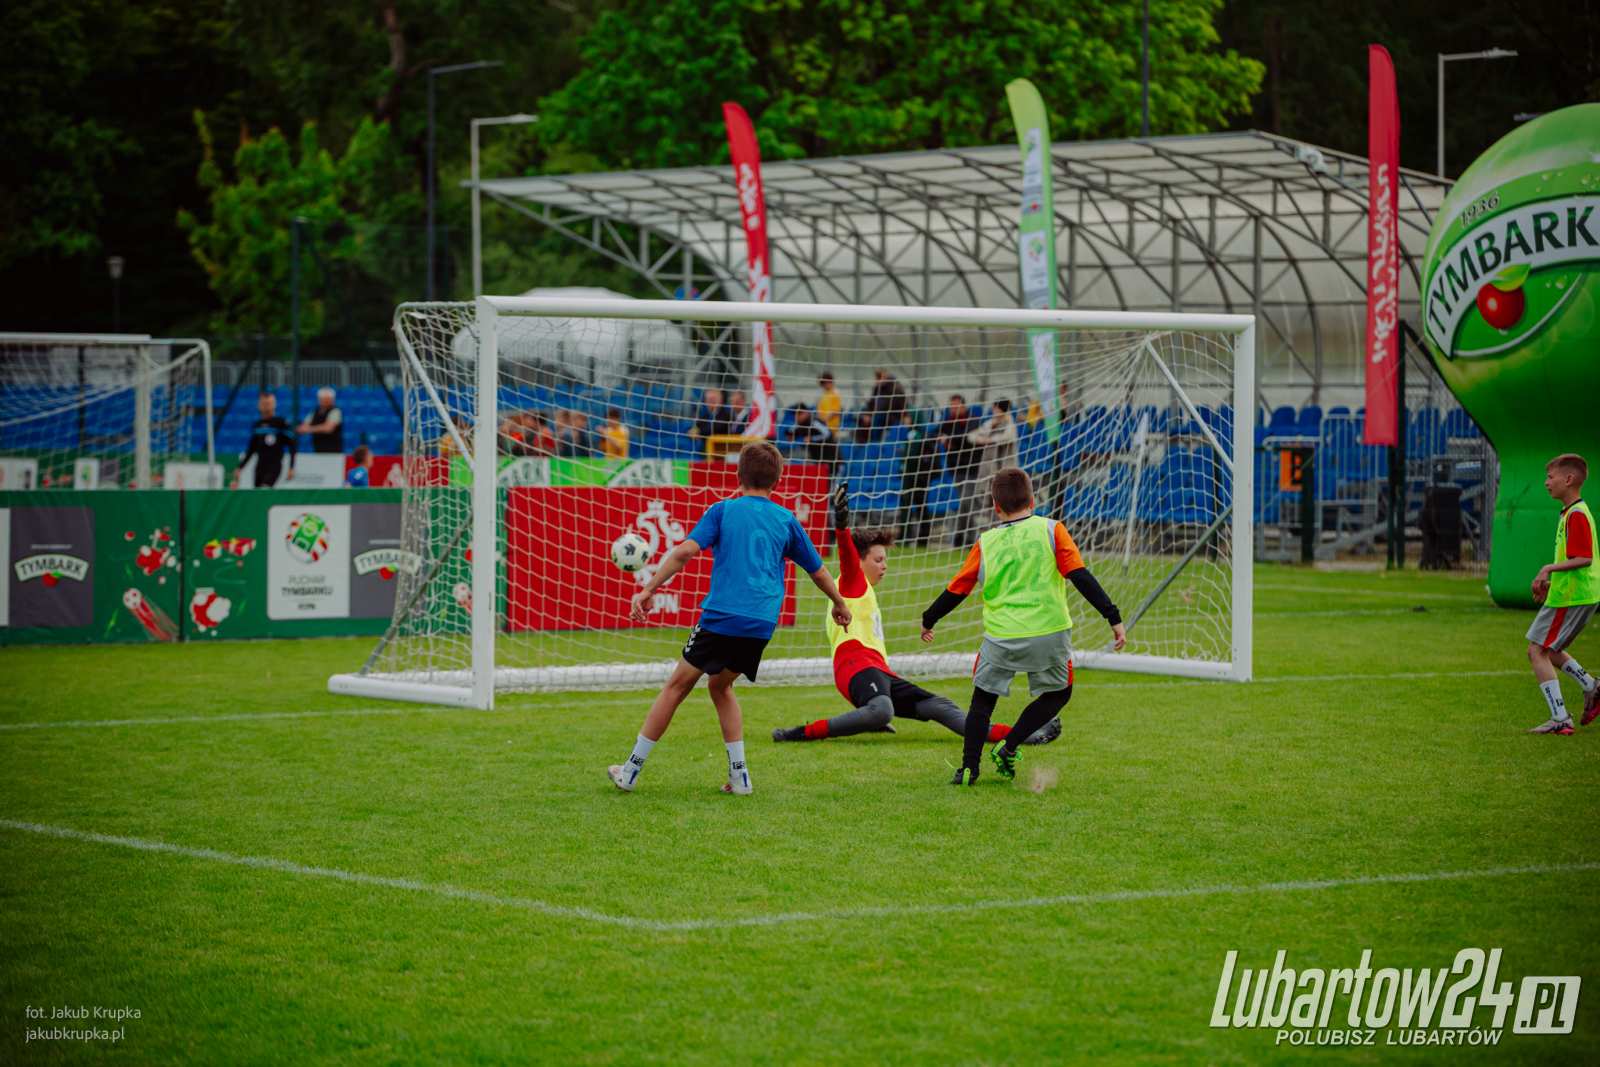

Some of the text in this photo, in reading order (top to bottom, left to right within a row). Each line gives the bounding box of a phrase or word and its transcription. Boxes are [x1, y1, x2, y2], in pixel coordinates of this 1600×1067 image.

[1460, 191, 1500, 228] 1936
[1428, 206, 1598, 335] TYMBARK
[20, 557, 83, 577] TYMBARK
